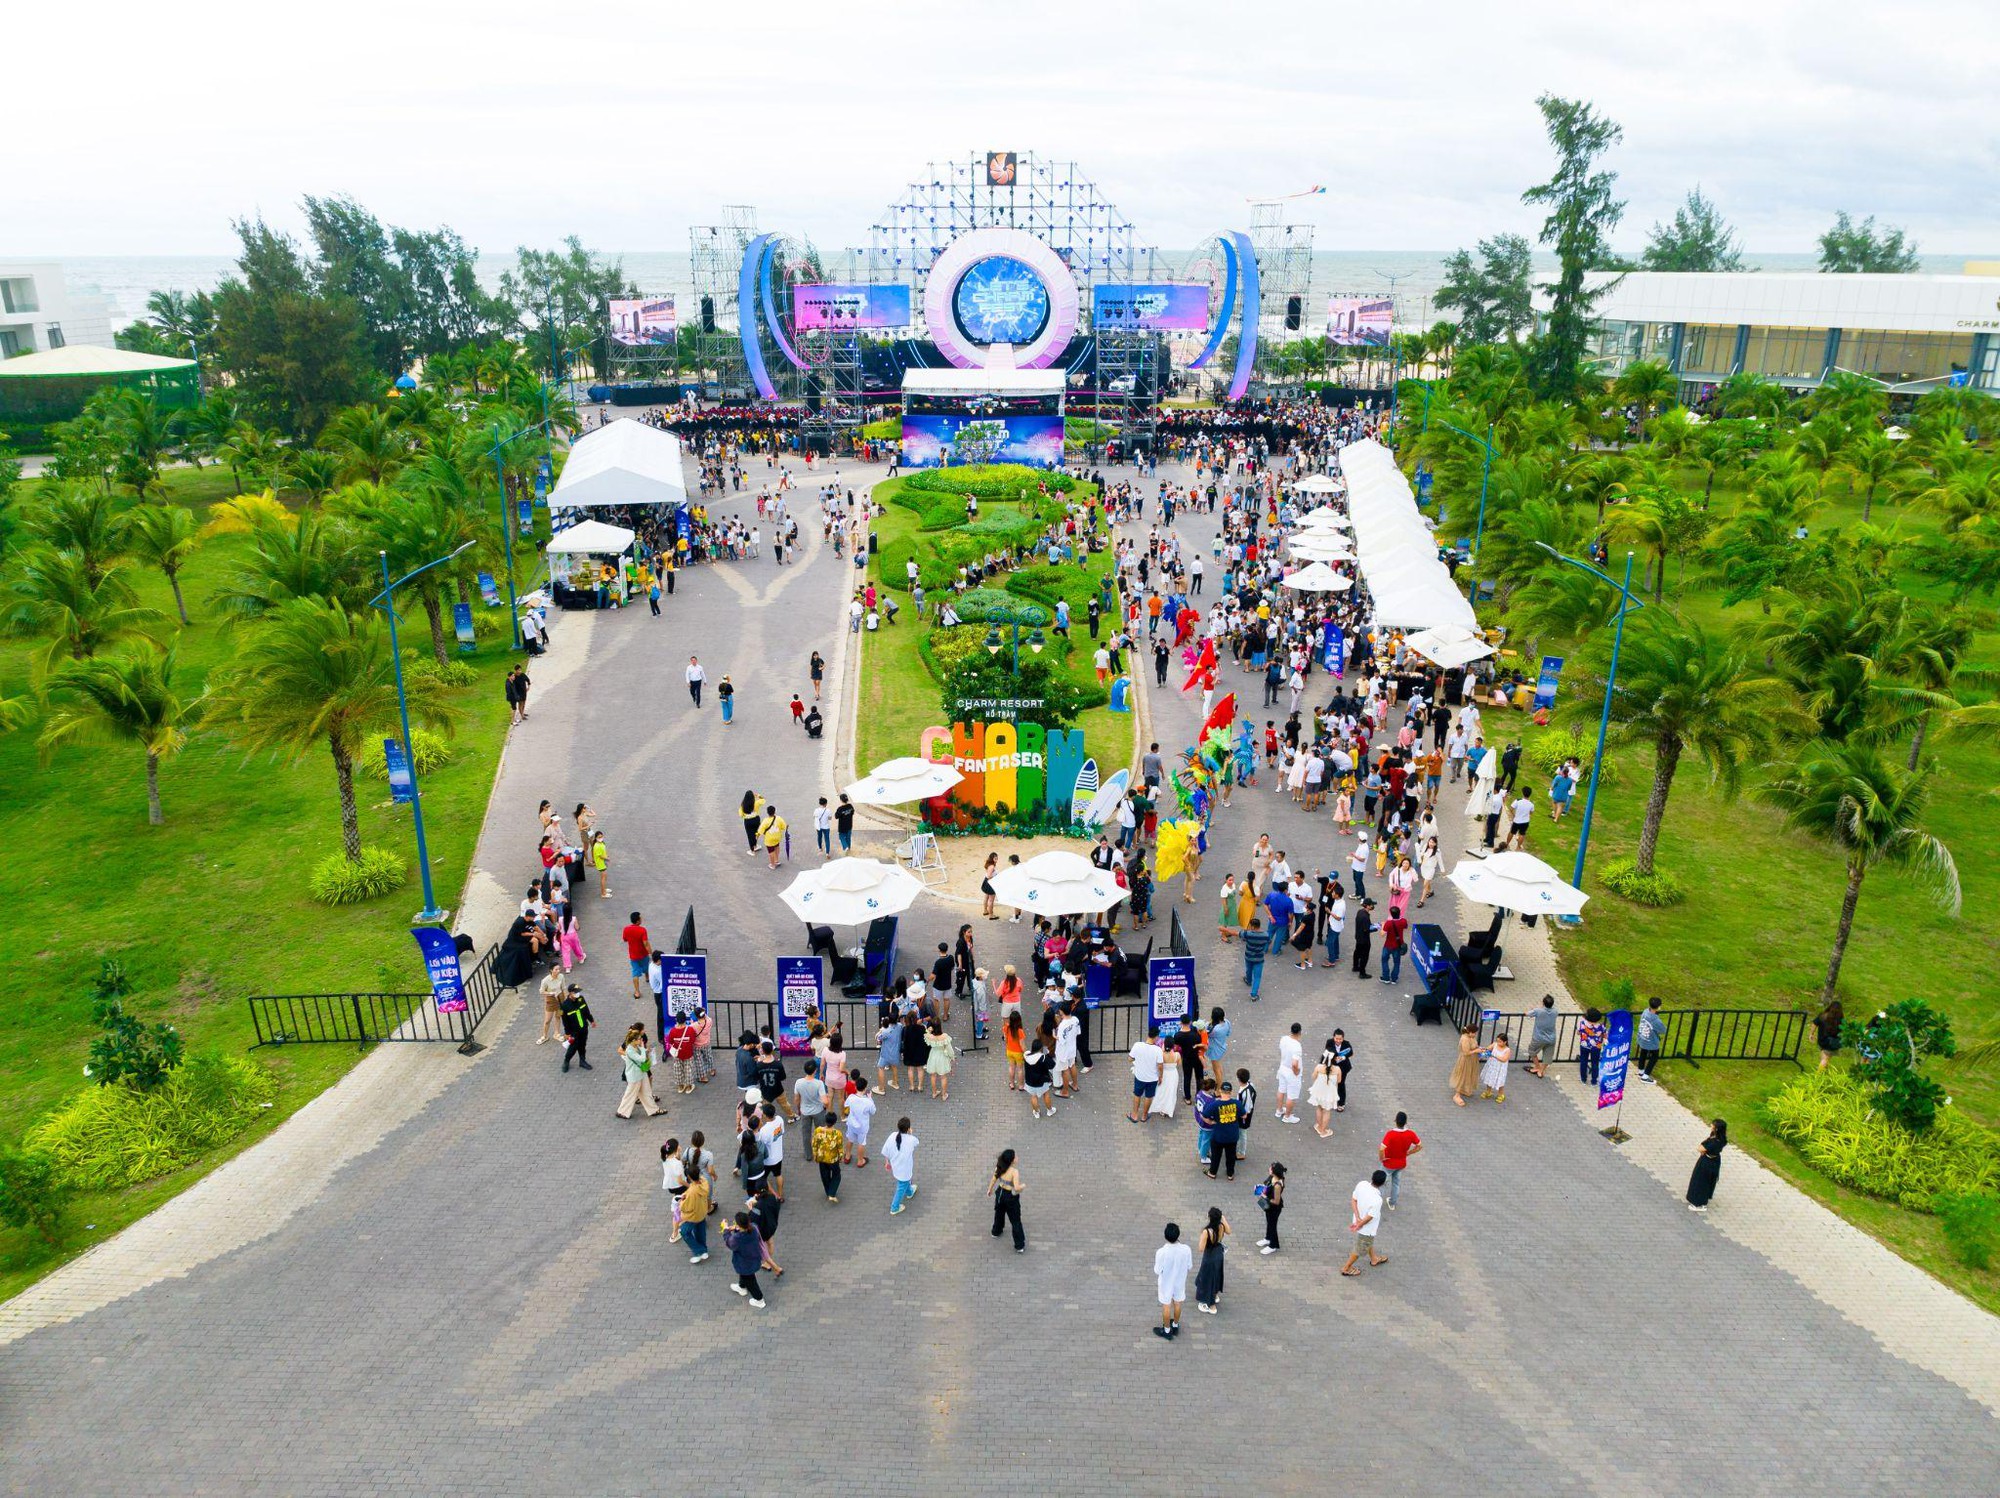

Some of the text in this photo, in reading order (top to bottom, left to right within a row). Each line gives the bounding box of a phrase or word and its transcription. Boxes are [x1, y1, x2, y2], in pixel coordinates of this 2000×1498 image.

[1956, 320, 2000, 328] CHARM
[957, 699, 1045, 708] CHARM RESORT
[954, 752, 1043, 773] FANTASEA
[921, 721, 1085, 824] CHARM
